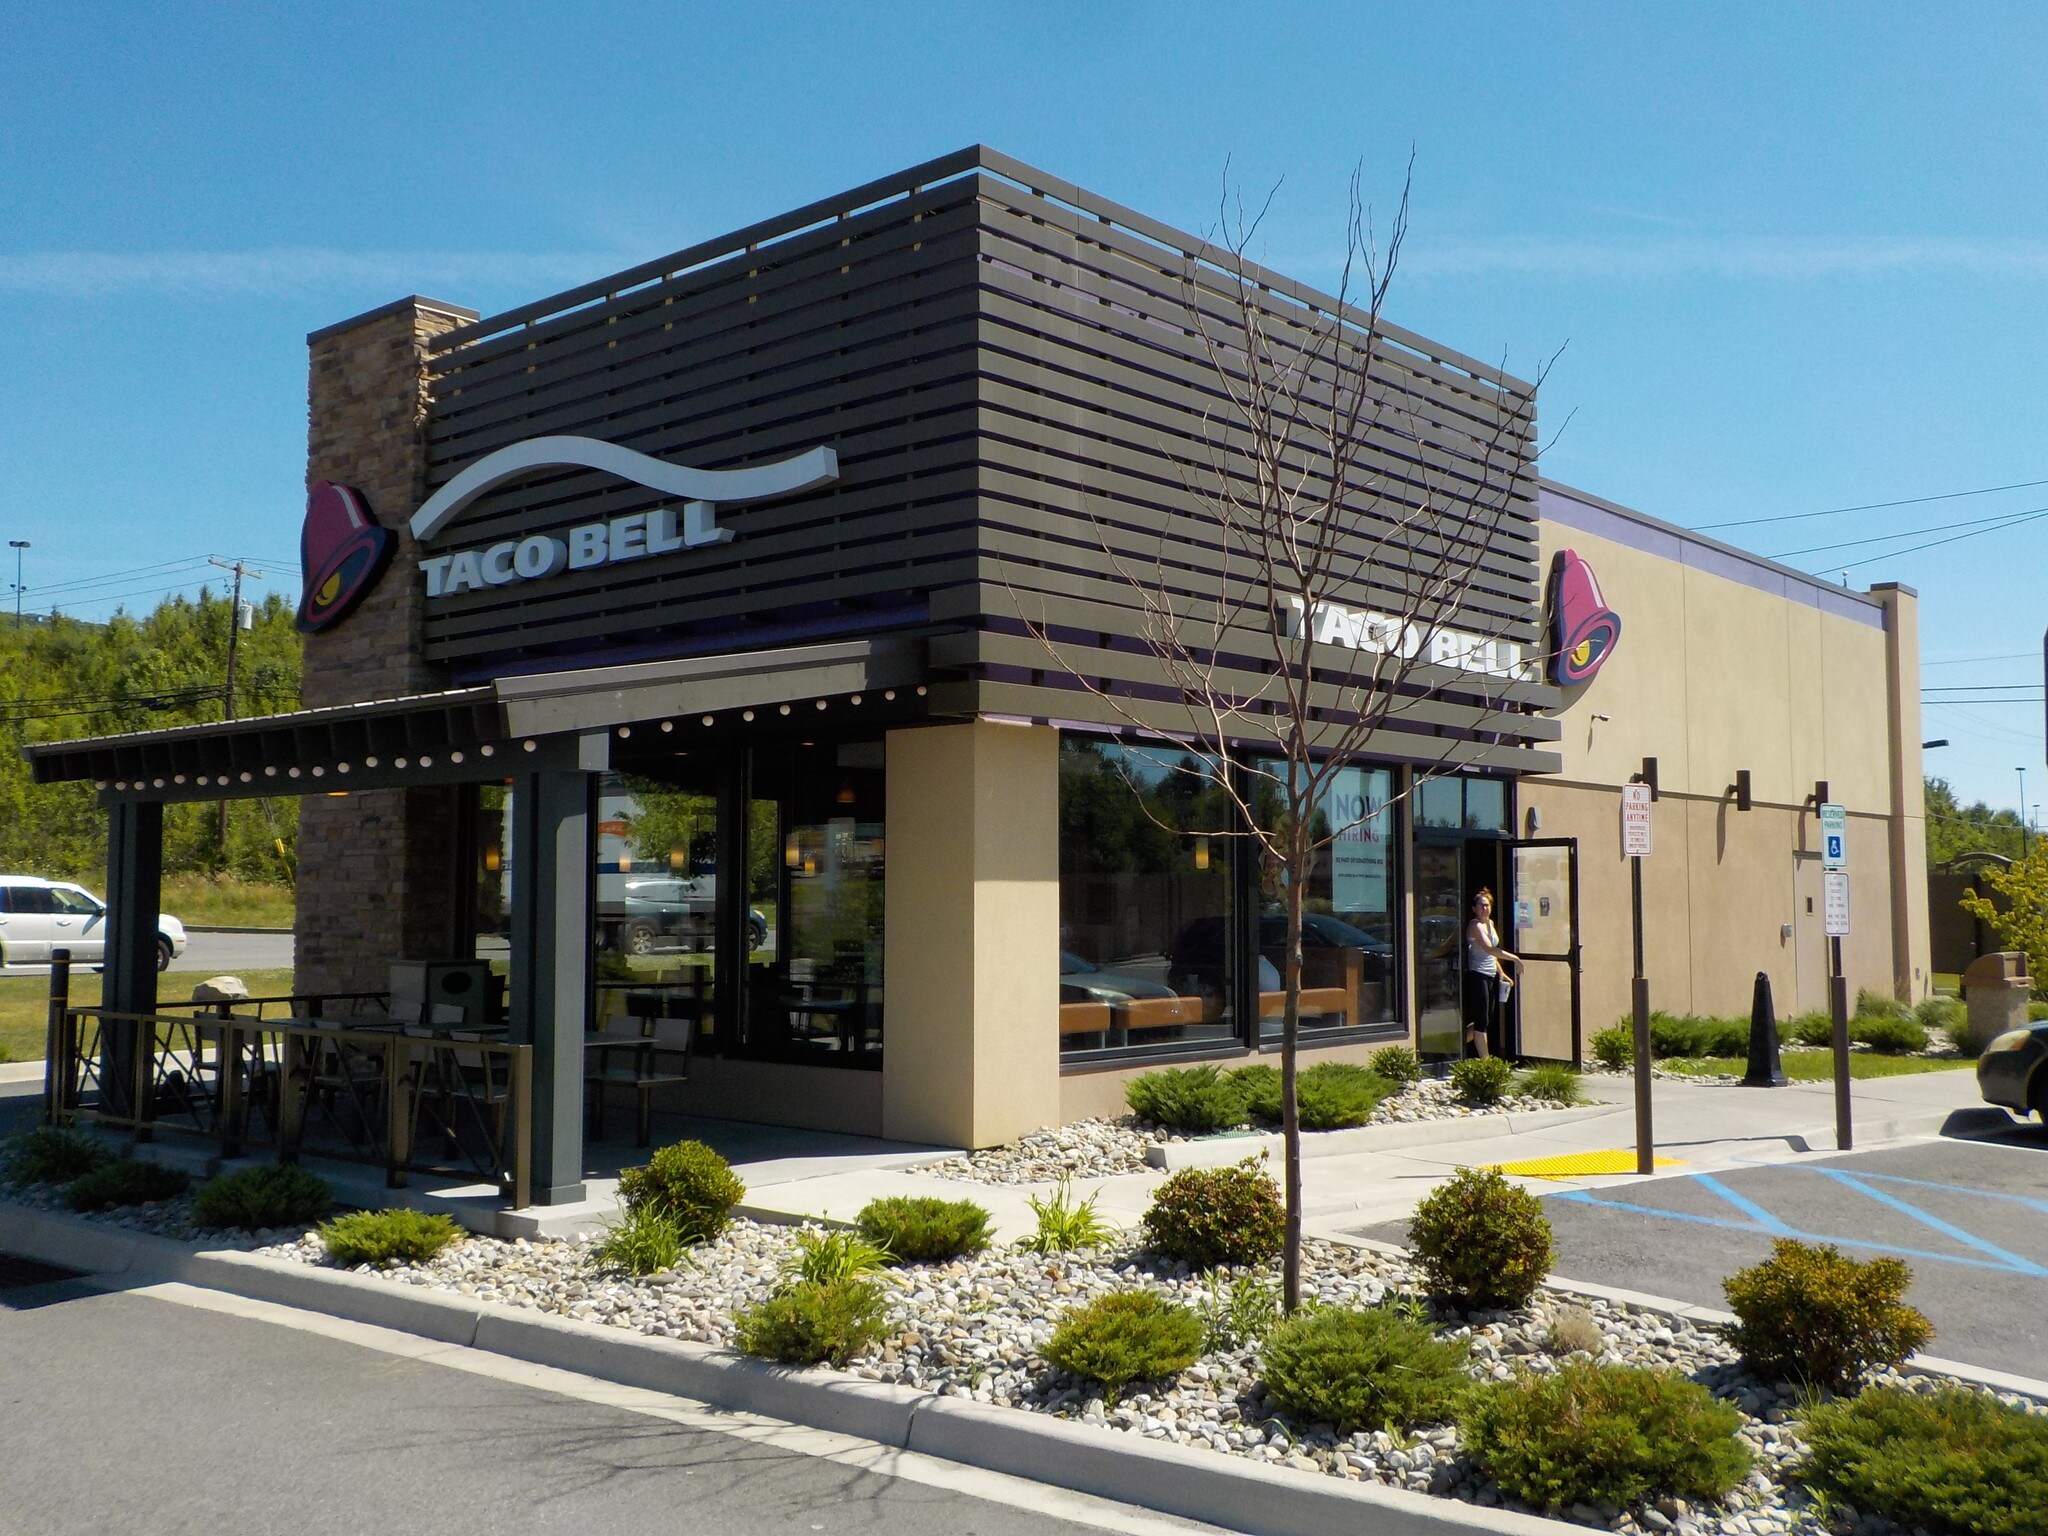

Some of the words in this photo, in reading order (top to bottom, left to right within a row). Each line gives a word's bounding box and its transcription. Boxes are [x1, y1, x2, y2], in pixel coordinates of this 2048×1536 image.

[418, 535, 567, 597] TACO
[568, 501, 735, 570] BELL
[1286, 595, 1420, 659] TACO
[1429, 625, 1534, 681] BELL
[1633, 789, 1640, 801] NO
[1336, 794, 1382, 822] NOW
[1626, 802, 1648, 811] PARKING
[1626, 814, 1648, 822] ANYTIME
[1338, 828, 1379, 843] HIRING
